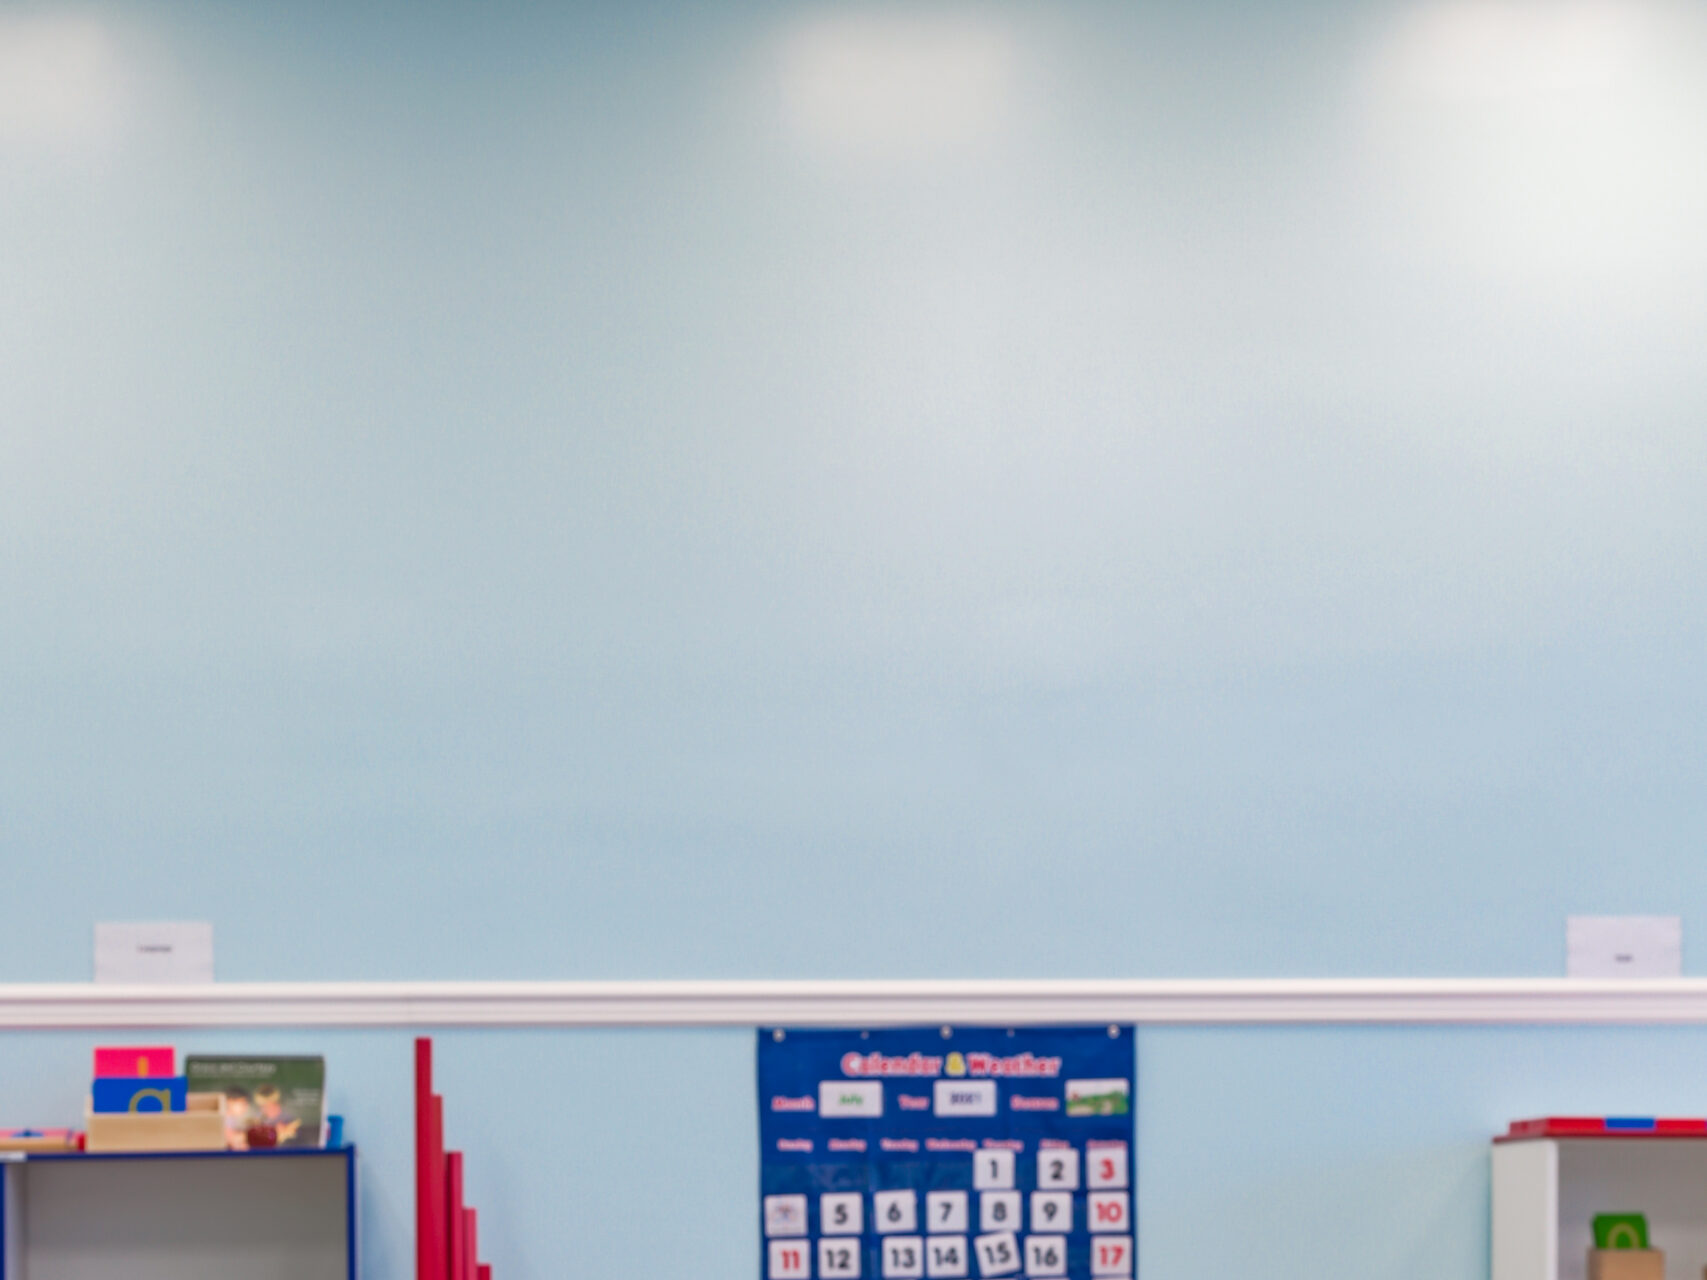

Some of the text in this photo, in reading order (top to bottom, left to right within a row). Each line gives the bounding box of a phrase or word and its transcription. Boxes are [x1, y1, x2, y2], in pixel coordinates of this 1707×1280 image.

[842, 1053, 1061, 1077] Calendar & Weather
[990, 1158, 1115, 1181] 1 2 3
[834, 1201, 1123, 1226] 5 6 7 8 9 10
[781, 1241, 1124, 1270] 11 12 13 14 15 16 17
